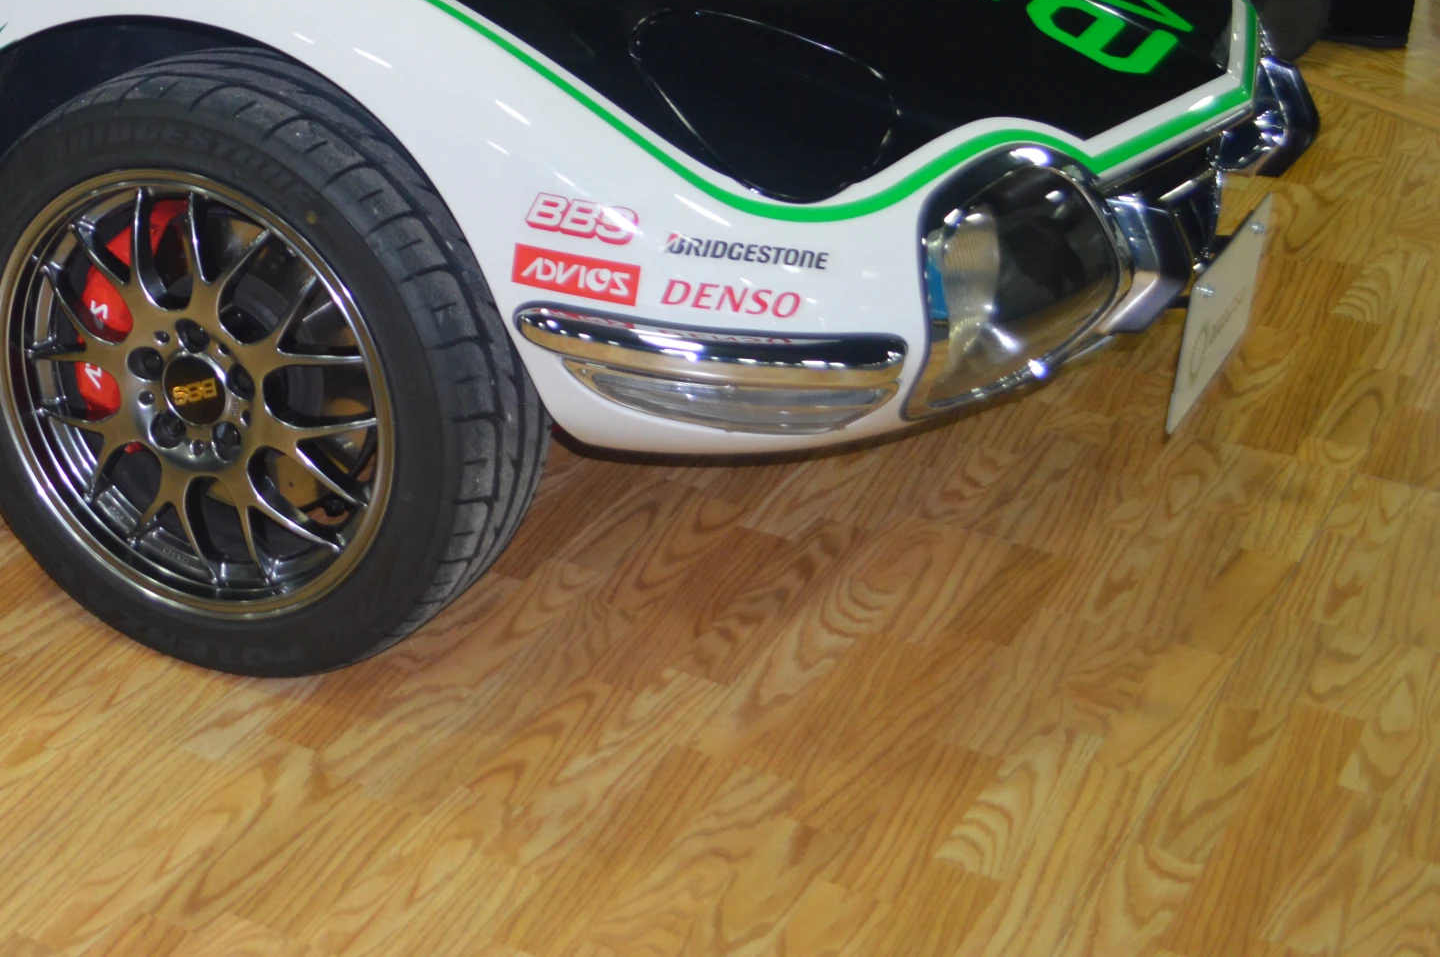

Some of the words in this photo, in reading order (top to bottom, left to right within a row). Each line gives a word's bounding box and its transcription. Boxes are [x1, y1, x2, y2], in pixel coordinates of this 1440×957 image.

[525, 192, 639, 246] BBS
[664, 232, 830, 271] BRIDGESTONE
[520, 256, 631, 296] ADVICS
[660, 279, 802, 319] DENSO
